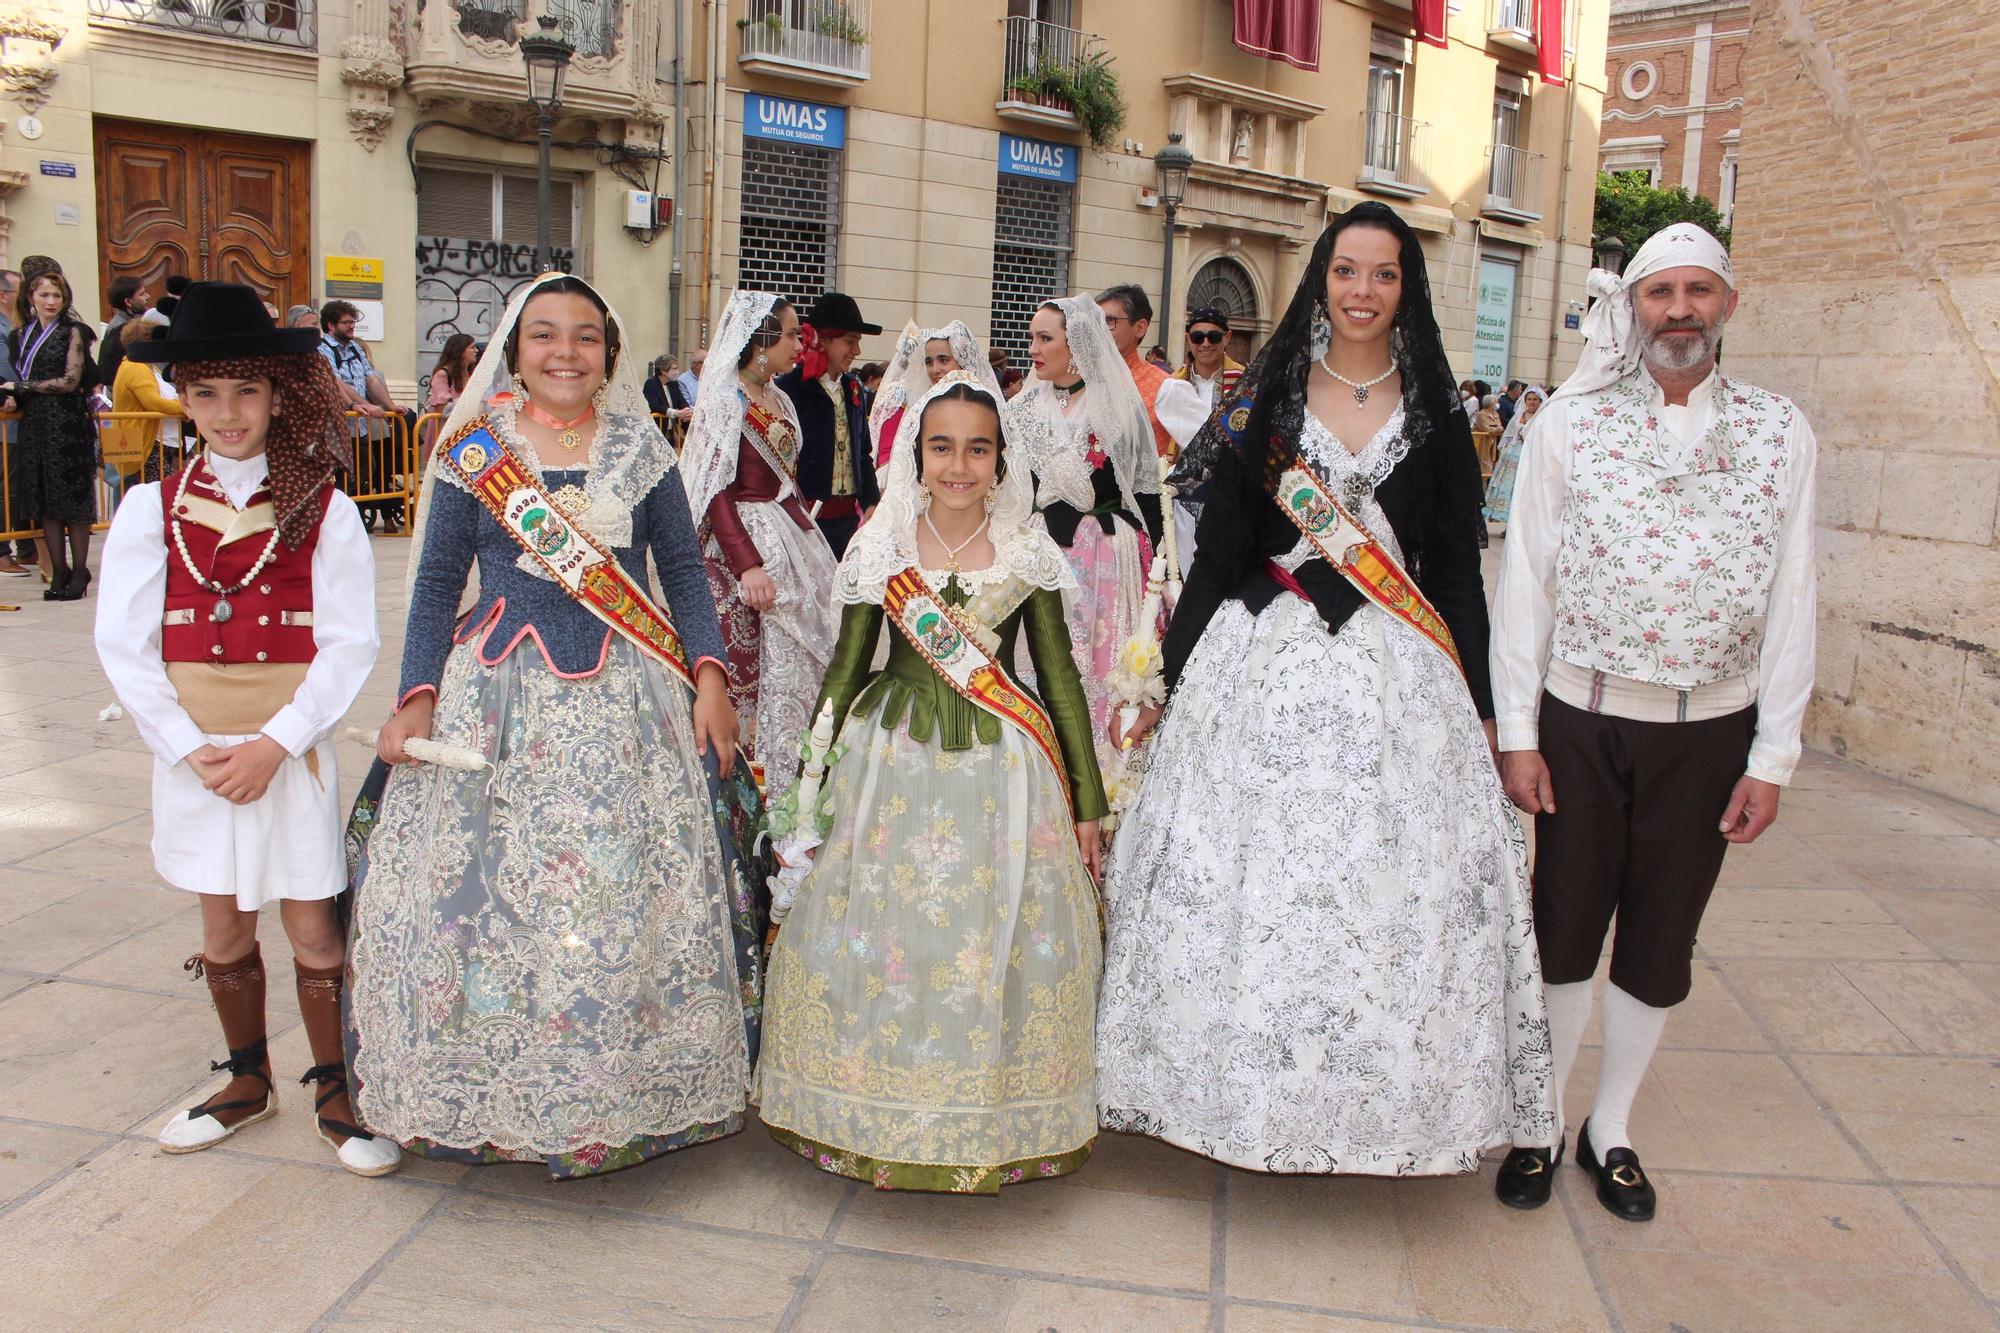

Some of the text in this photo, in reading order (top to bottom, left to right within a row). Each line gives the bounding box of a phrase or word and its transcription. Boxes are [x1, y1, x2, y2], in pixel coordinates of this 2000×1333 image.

[760, 99, 827, 132] UMAS
[25, 119, 36, 136] 4
[762, 126, 824, 142] MUTUA DE SEGUROS
[1010, 139, 1064, 168] UMAS
[1011, 163, 1030, 173] MUTUA
[1038, 168, 1061, 177] SEGUROS
[1476, 314, 1506, 328] Oficina de
[1475, 328, 1505, 342] Atención
[1485, 364, 1502, 377] 100
[510, 494, 538, 520] 2020
[560, 549, 587, 573] 2021
